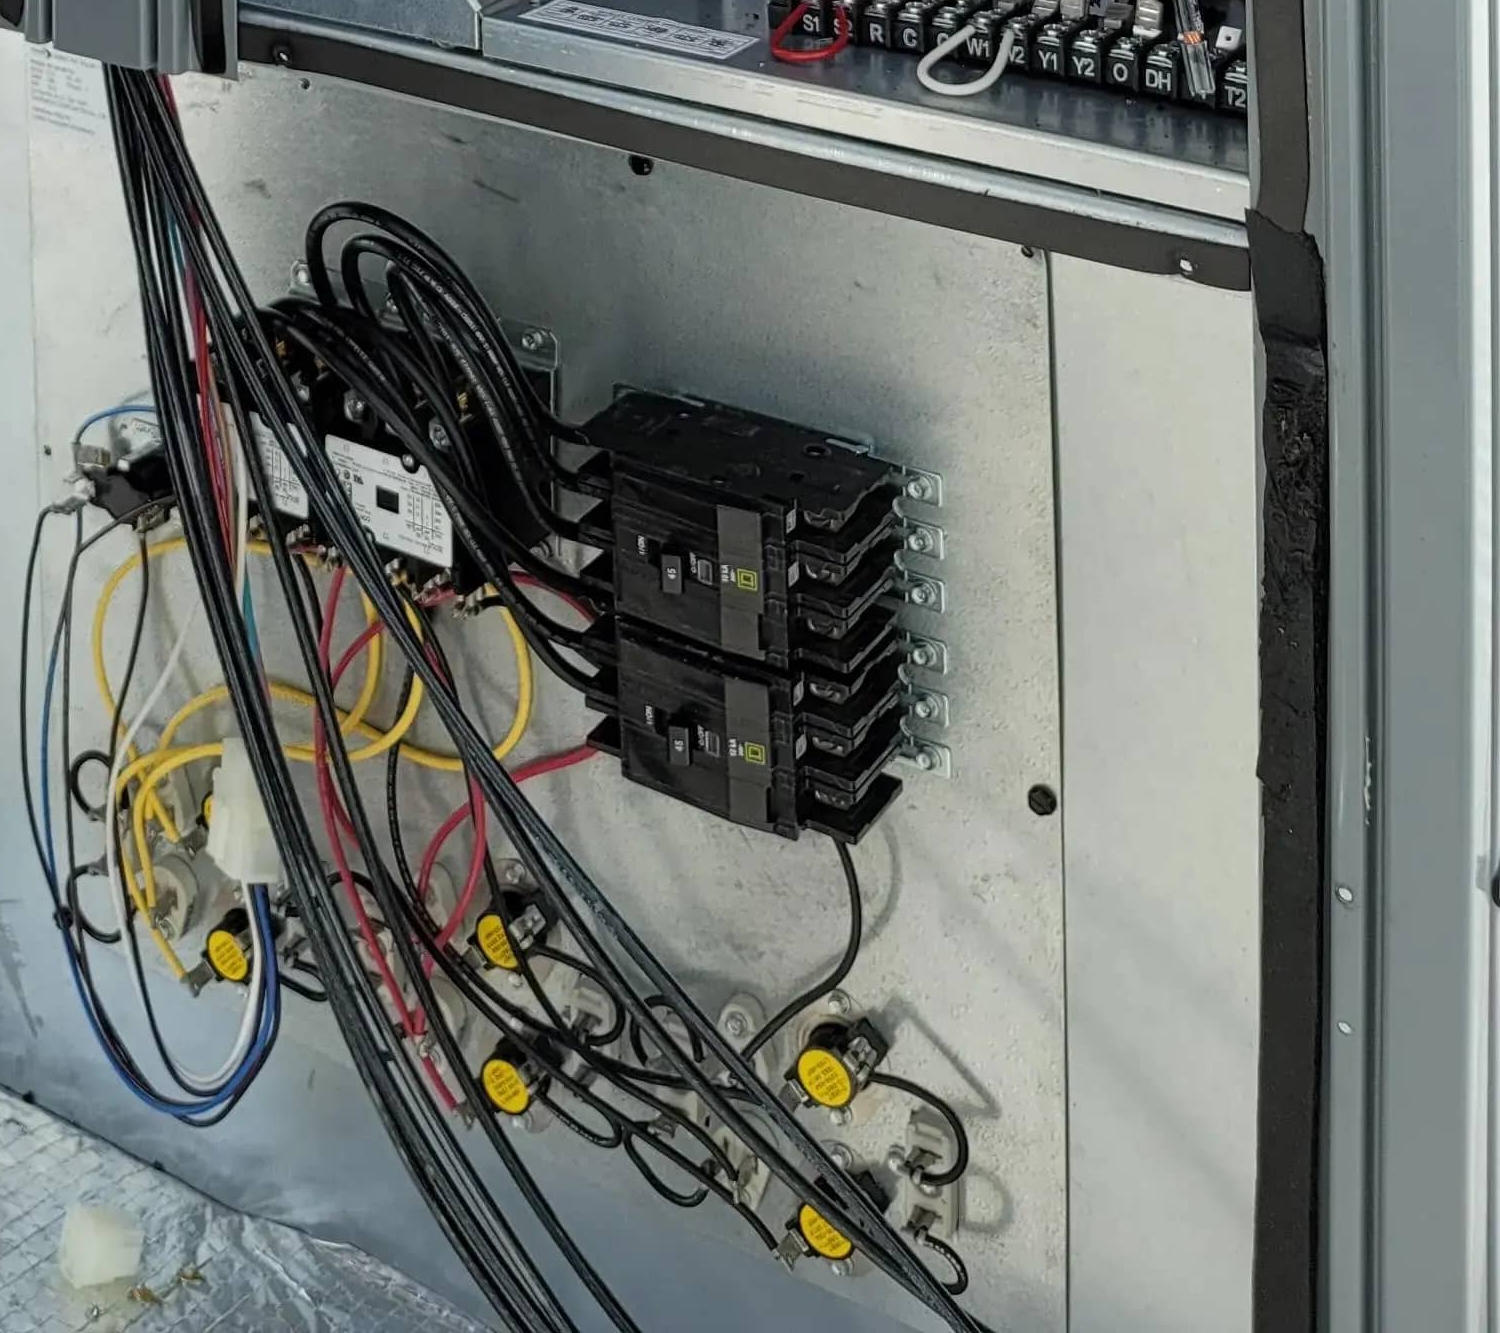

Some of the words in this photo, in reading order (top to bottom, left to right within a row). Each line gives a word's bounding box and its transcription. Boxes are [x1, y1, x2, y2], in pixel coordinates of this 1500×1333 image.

[802, 14, 820, 32] S1
[869, 23, 884, 43] R
[902, 28, 917, 47] C
[966, 36, 991, 58] W1
[1037, 50, 1058, 71] Y1
[1071, 56, 1095, 77] Y2
[1112, 63, 1128, 83] O
[1145, 69, 1172, 92] DH
[1224, 84, 1247, 108] T2
[666, 567, 677, 580] 45
[673, 739, 684, 752] 45
